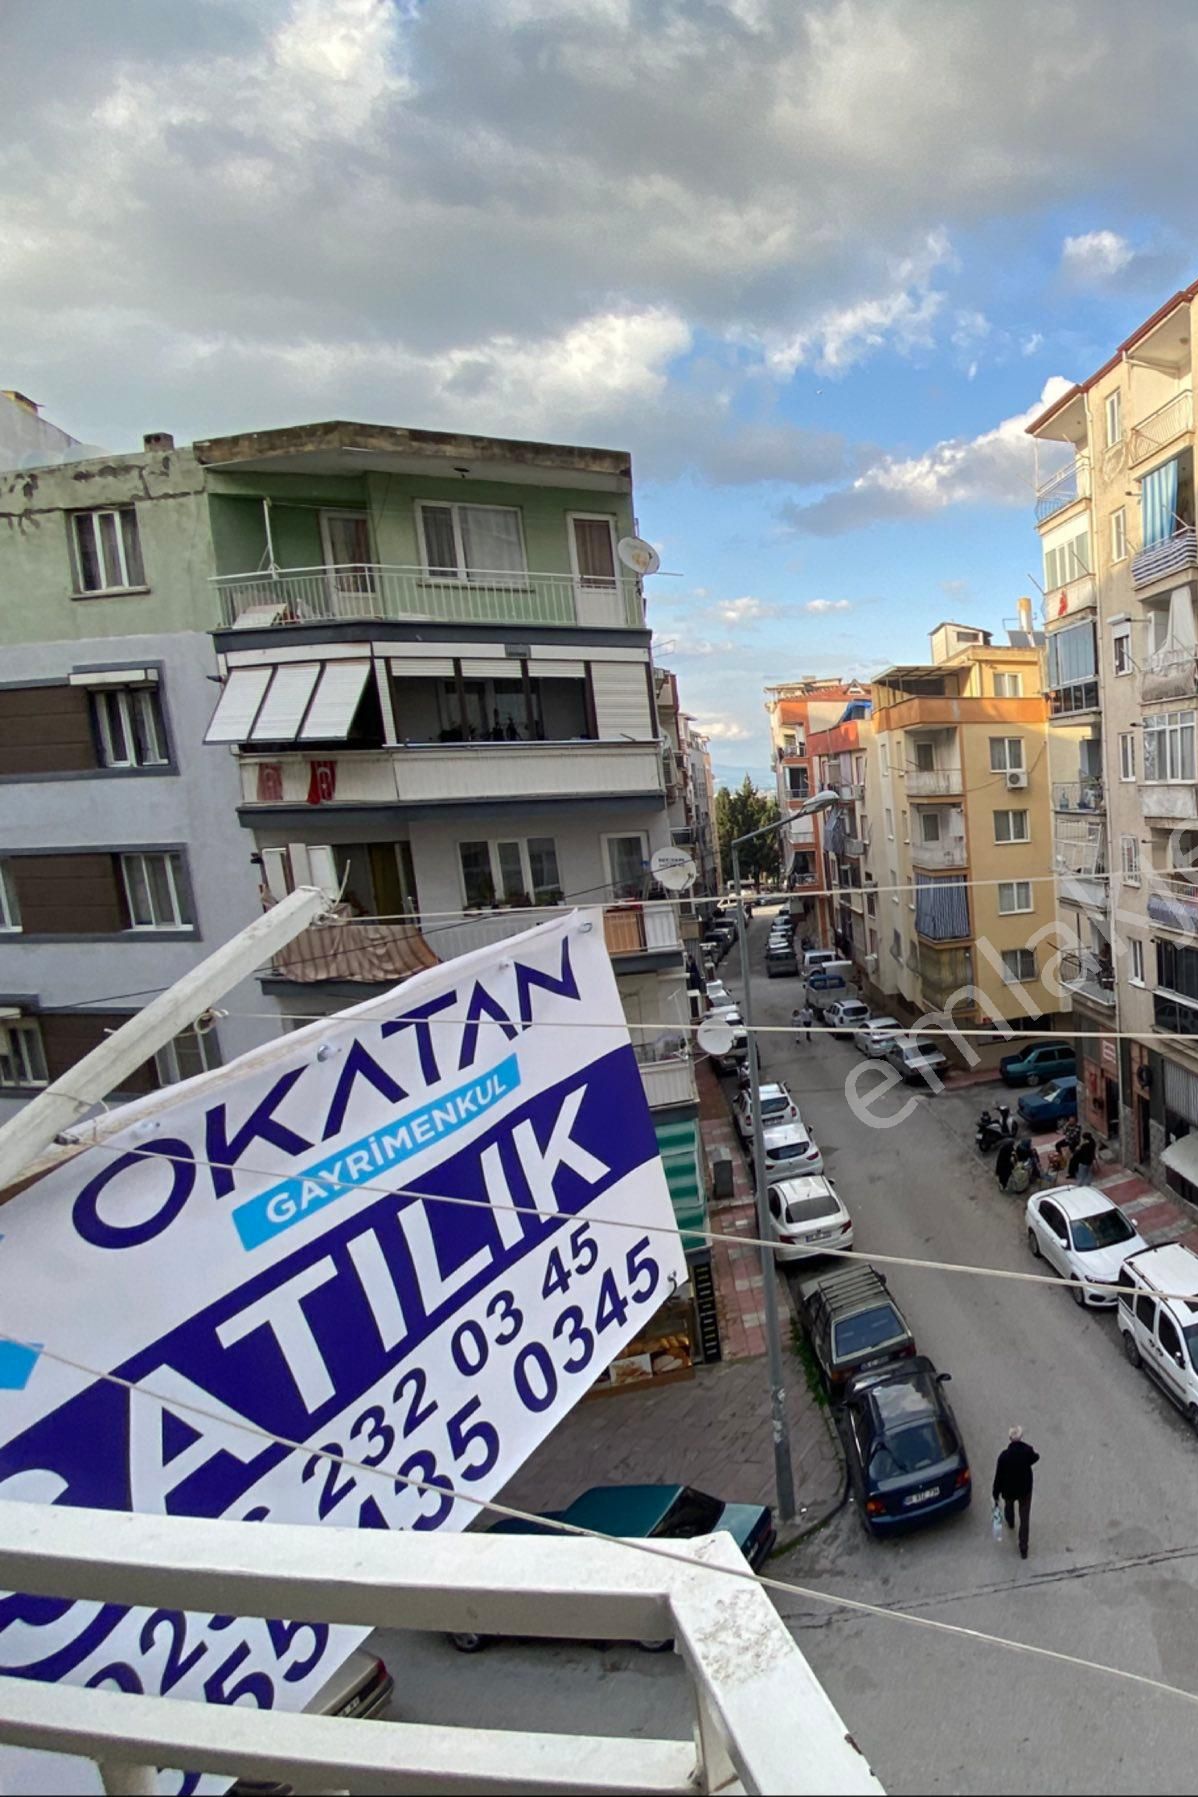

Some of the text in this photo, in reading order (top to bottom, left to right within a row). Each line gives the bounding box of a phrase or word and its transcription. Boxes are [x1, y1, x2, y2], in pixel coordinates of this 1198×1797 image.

[72, 936, 580, 1249] OKATAN
[265, 1075, 508, 1224] GAYRİMENKUL
[301, 1221, 599, 1521] 232 03 45
[513, 1235, 660, 1413] 0345
